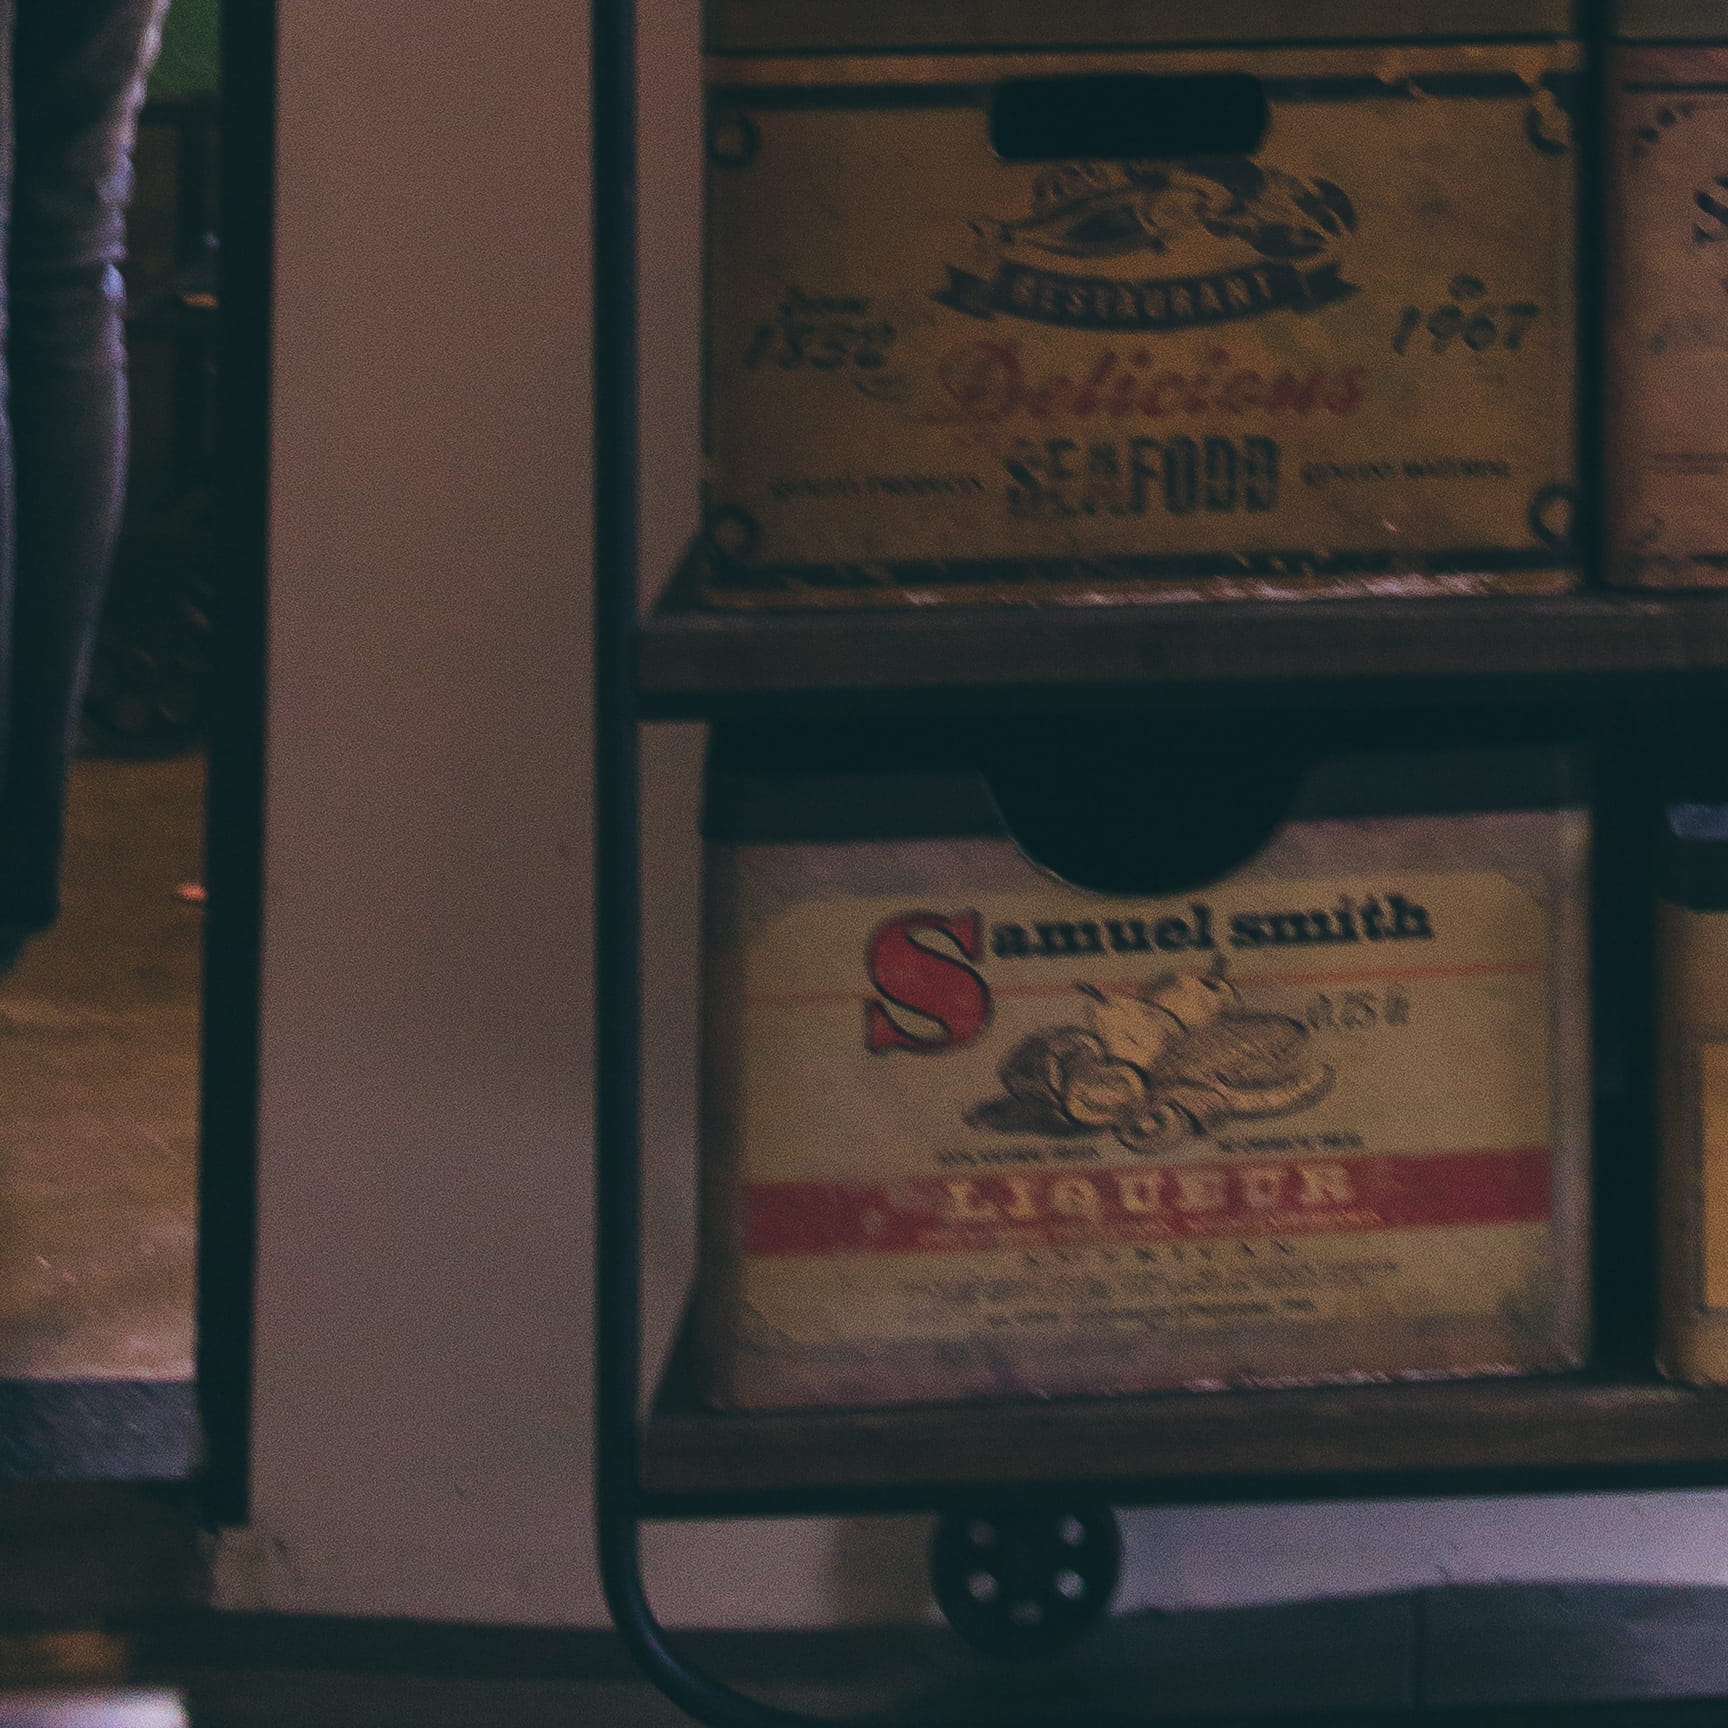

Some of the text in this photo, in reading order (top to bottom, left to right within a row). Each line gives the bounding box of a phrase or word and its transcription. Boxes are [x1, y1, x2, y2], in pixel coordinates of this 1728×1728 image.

[1011, 270, 1273, 319] RESTAURANT
[923, 341, 1368, 424] Delicious
[1005, 434, 1281, 518] SEAFOOD
[865, 894, 1434, 1055] Samuel smith
[946, 1162, 1357, 1220] LIQUEUR
